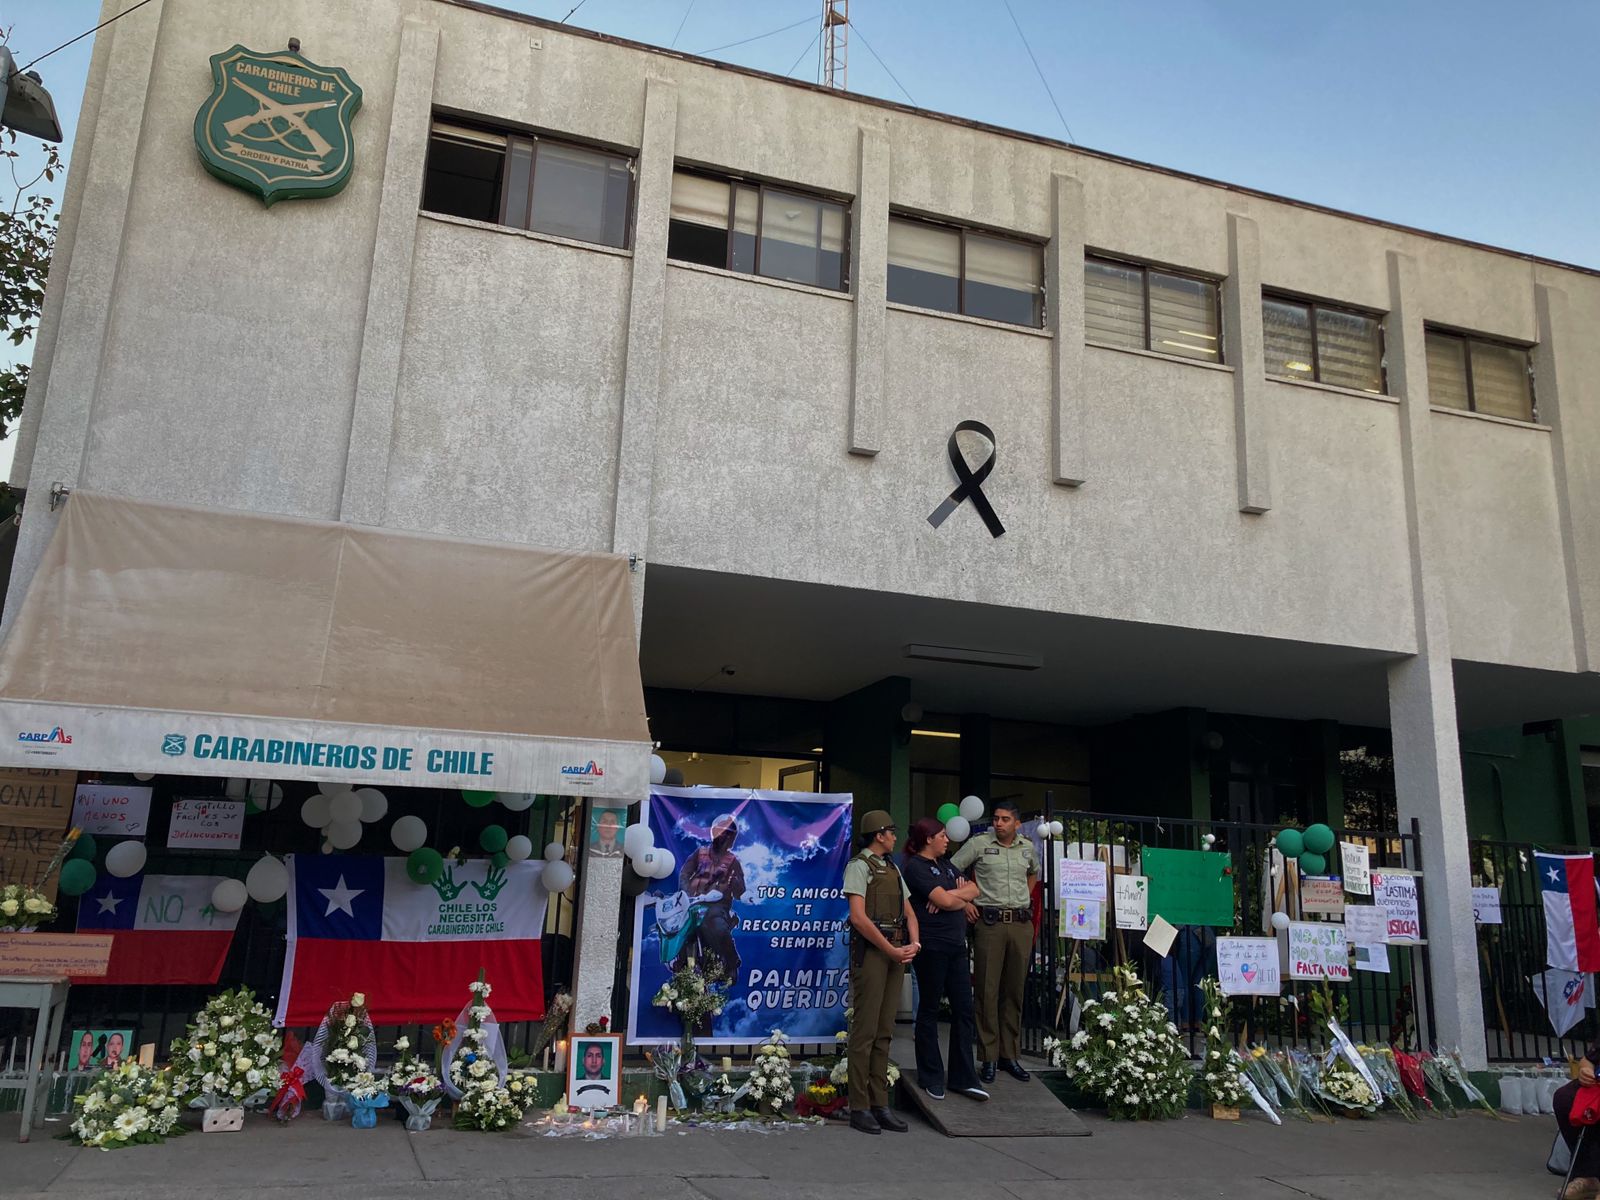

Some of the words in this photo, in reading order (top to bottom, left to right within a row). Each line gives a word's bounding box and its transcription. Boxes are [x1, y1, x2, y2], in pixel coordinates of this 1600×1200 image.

[236, 62, 318, 89] CARABINEROS
[321, 80, 336, 93] DE
[268, 80, 301, 97] CHILE
[240, 149, 271, 162] ORDEN
[280, 158, 309, 170] PATRIA
[193, 734, 377, 770] CARABINEROS
[382, 747, 413, 771] DE
[427, 749, 494, 776] CHILE
[103, 797, 129, 806] UNO
[84, 811, 127, 822] MENOS
[1371, 873, 1383, 886] NO
[441, 884, 452, 892] NO
[486, 882, 497, 891] NO
[757, 886, 786, 899] TUS
[143, 894, 184, 924] NO
[438, 903, 472, 913] CHILE
[476, 903, 497, 912] LOS
[795, 904, 812, 916] TE
[439, 913, 495, 923] NECESITA
[427, 924, 474, 935] CARABINEROS
[475, 923, 484, 934] DE
[485, 922, 505, 933] CHILE
[1387, 919, 1419, 937] USTICIA
[770, 937, 835, 949] SIEMPRE
[1296, 961, 1325, 976] FALTA
[1327, 965, 1348, 977] UNO
[748, 968, 851, 988] PALMITA
